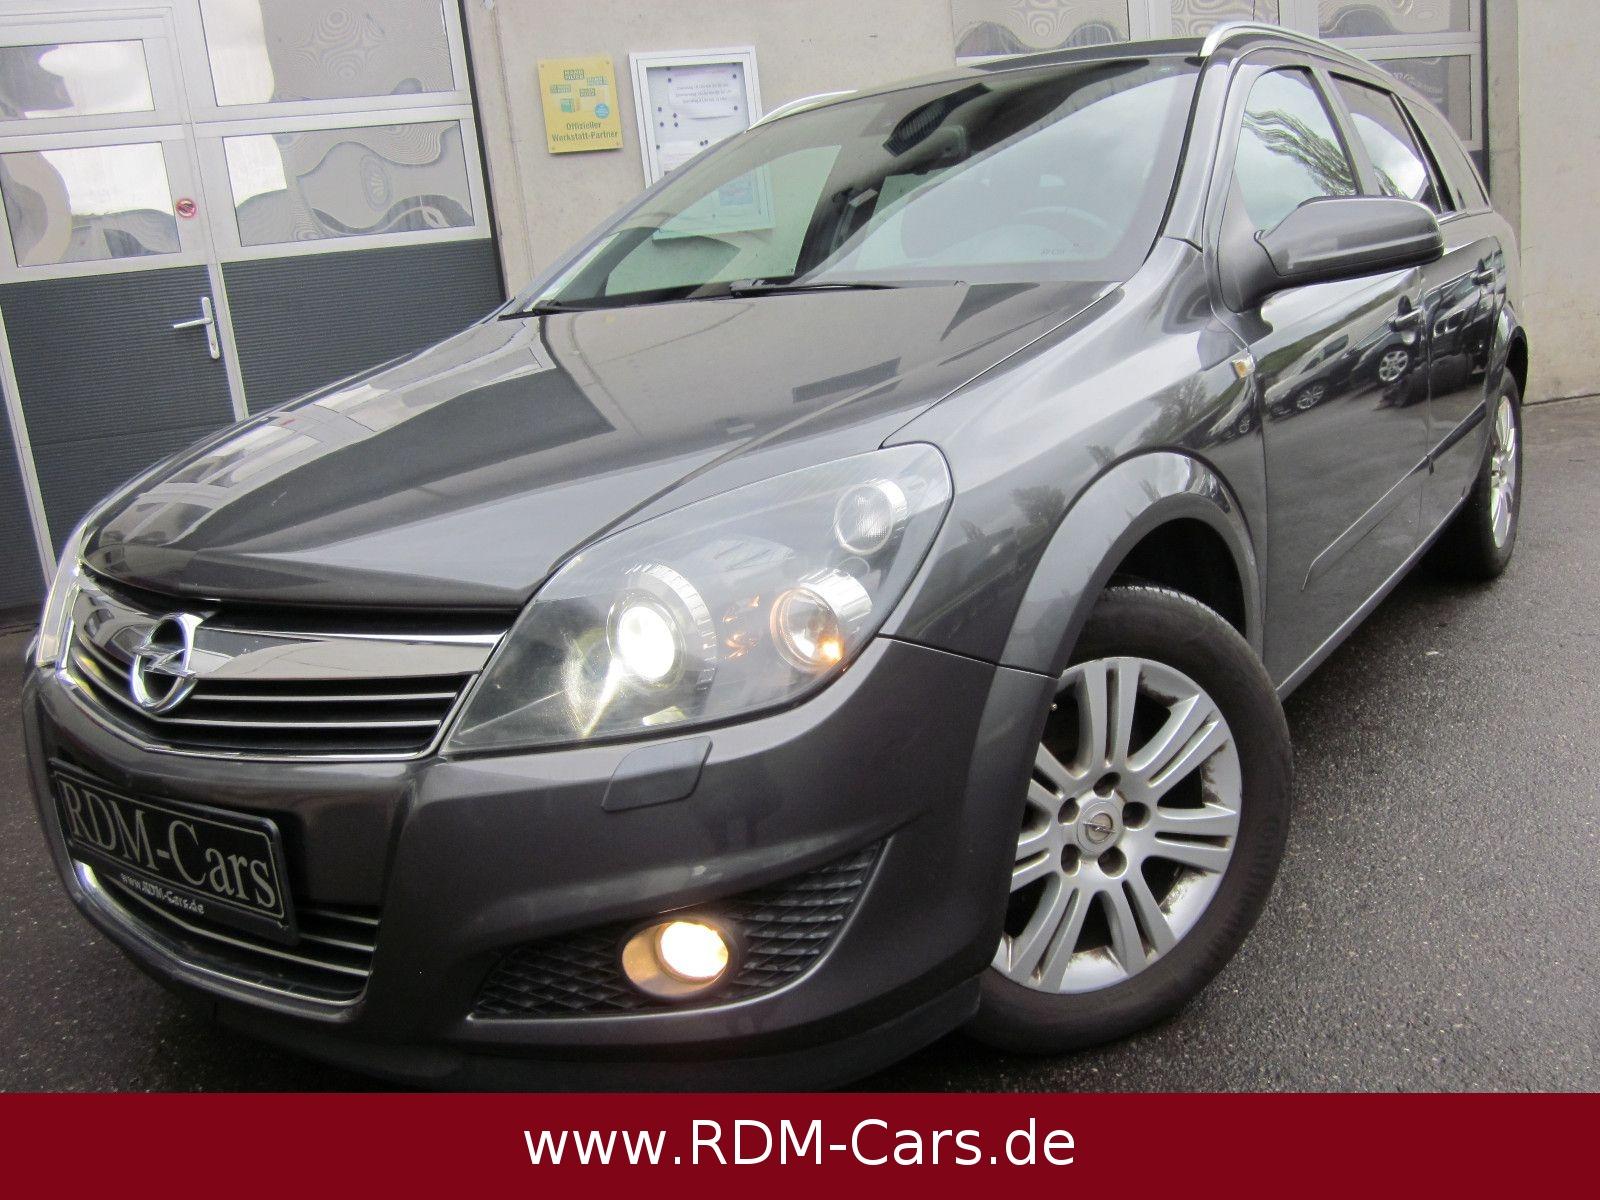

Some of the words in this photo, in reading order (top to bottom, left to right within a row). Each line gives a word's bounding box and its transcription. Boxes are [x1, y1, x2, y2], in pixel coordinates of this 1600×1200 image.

[566, 121, 601, 131] Offizieller
[551, 130, 618, 142] Werkstatt-Partner
[60, 781, 276, 909] RDM-Cars
